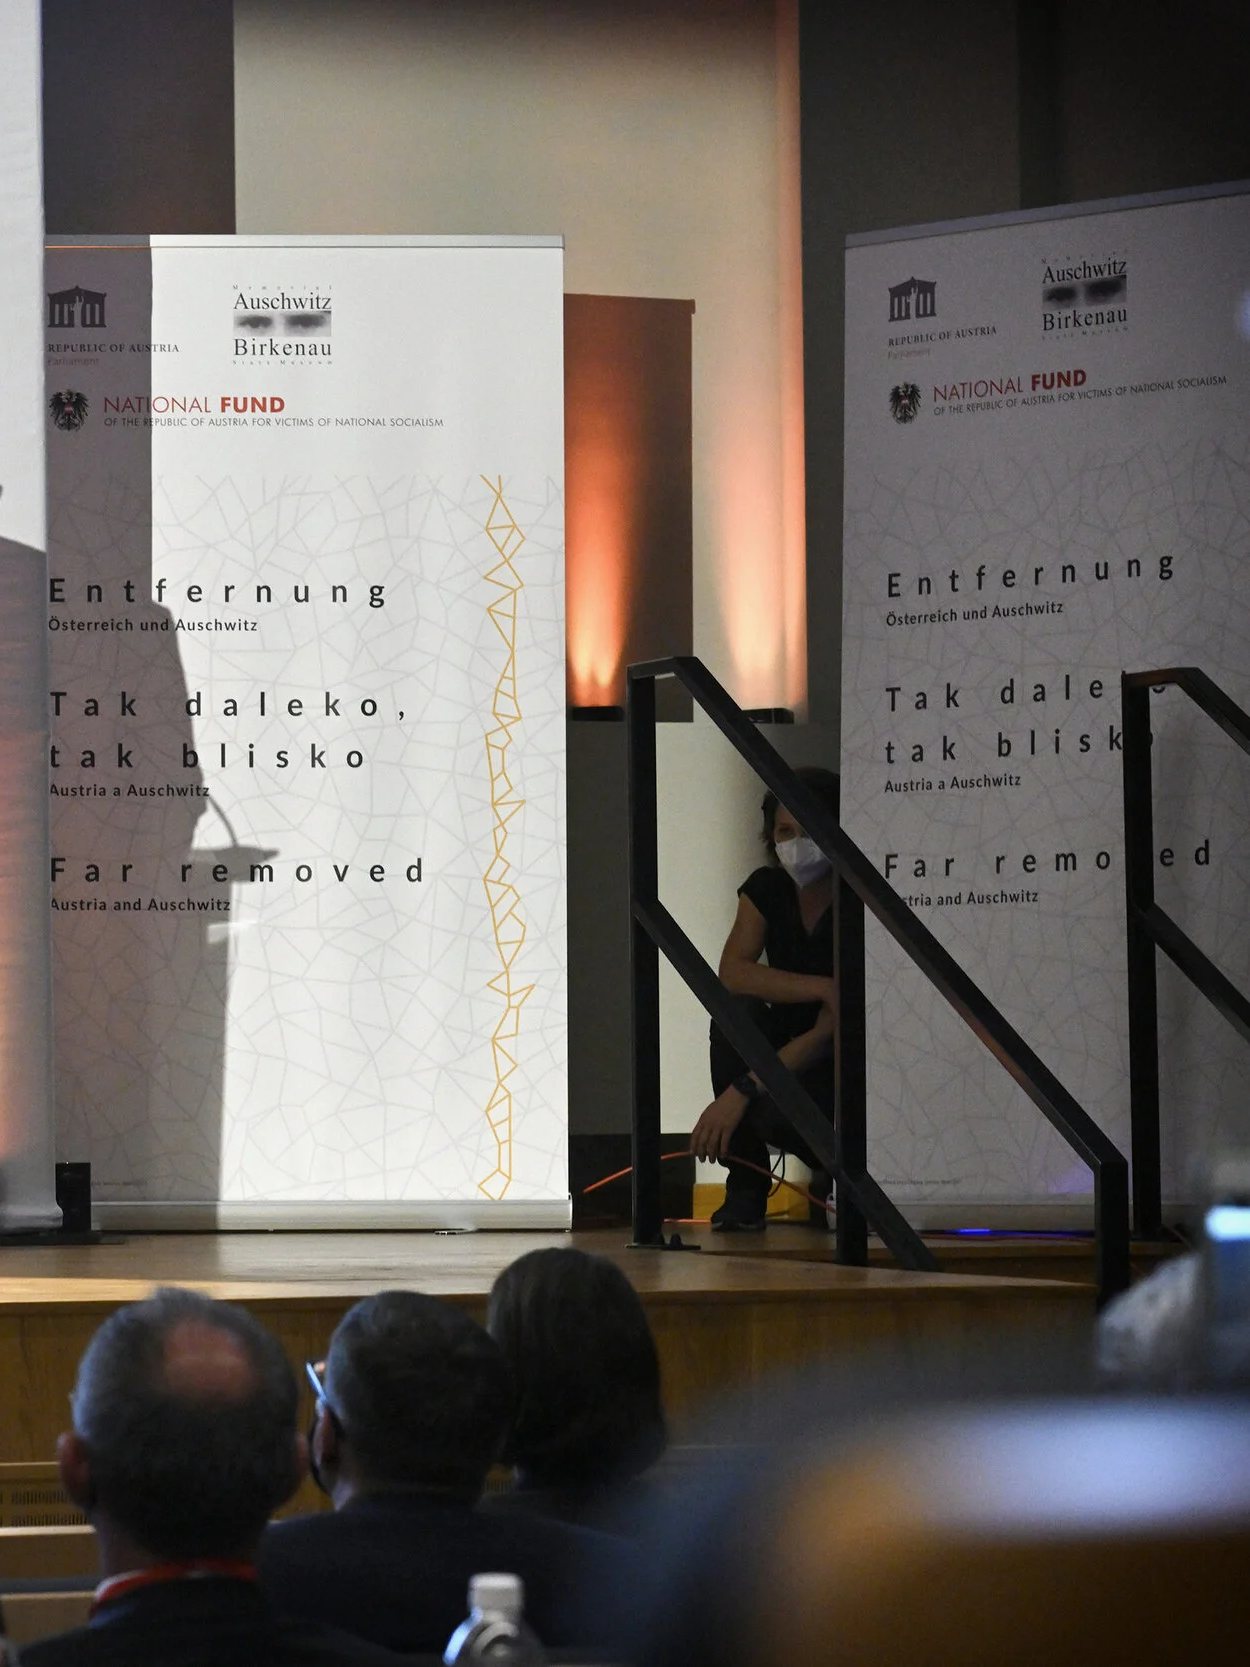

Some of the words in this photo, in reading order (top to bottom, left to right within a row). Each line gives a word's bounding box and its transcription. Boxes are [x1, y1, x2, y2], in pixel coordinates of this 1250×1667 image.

[1042, 258, 1127, 284] Auschwitz
[233, 292, 332, 310] Auschwitz
[1042, 309, 1127, 331] Birkenau
[233, 338, 332, 356] Birkenau
[888, 334, 936, 347] REPUBLIC
[939, 331, 951, 341] OF
[954, 325, 997, 339] AUSTRIA
[48, 344, 107, 353] REPUBLIC
[109, 344, 125, 353] OF
[129, 344, 180, 353] AUSTRIA
[934, 376, 1024, 402] NATIONAL
[1031, 369, 1087, 391] FUND
[934, 406, 946, 416] OF
[949, 404, 964, 414] THE
[966, 400, 1003, 412] REPUBLIC
[1006, 398, 1018, 408] OF
[1021, 394, 1056, 406] AUSTRIA
[1058, 391, 1075, 402] FOR
[1078, 387, 1112, 400] VICTIMS
[1116, 386, 1127, 396] OF
[1130, 380, 1174, 393] NATIONAL
[1177, 375, 1227, 389] SOCIALISM
[104, 396, 211, 413] NATIONAL
[220, 396, 285, 413] FUND
[104, 417, 118, 427] OF
[122, 417, 142, 427] THE
[144, 417, 187, 427] REPUBLIC
[191, 417, 205, 427] OF
[208, 417, 248, 427] AUSTRIA
[252, 417, 272, 427] FOR
[275, 417, 314, 427] VICTIMS
[318, 417, 332, 427] OF
[335, 417, 386, 427] NATIONAL
[390, 417, 444, 427] SOCIALISM
[887, 555, 1174, 598] Entfernung
[50, 578, 385, 608] Entfernung
[48, 615, 134, 631] Österreich
[140, 618, 169, 632] und
[175, 618, 258, 632] Auschwitz
[886, 607, 958, 626] Österreich
[963, 606, 988, 621] und
[992, 602, 1064, 618] Auschwitz
[886, 683, 960, 712] Tak
[1000, 674, 1166, 704] dale
[50, 691, 137, 717] Tak
[185, 691, 405, 720] daleko,
[50, 743, 134, 768] tak
[182, 743, 364, 768] blisko
[885, 735, 956, 764] tak
[998, 725, 1153, 757] blisk
[50, 784, 107, 796] Austria
[112, 787, 121, 796] a
[127, 783, 210, 797] Auschwitz
[884, 779, 933, 793] Austria
[938, 780, 945, 790] a
[950, 774, 1021, 790] Auschwitz
[51, 857, 133, 882] Far
[181, 857, 422, 882] removed
[884, 854, 955, 879] Far
[995, 838, 1210, 877] remoed
[51, 898, 107, 911] Austria
[113, 898, 142, 911] and
[148, 898, 231, 911] Auschwitz
[901, 892, 933, 907] tria
[937, 891, 962, 906] and
[967, 889, 1039, 906] Auschwitz
